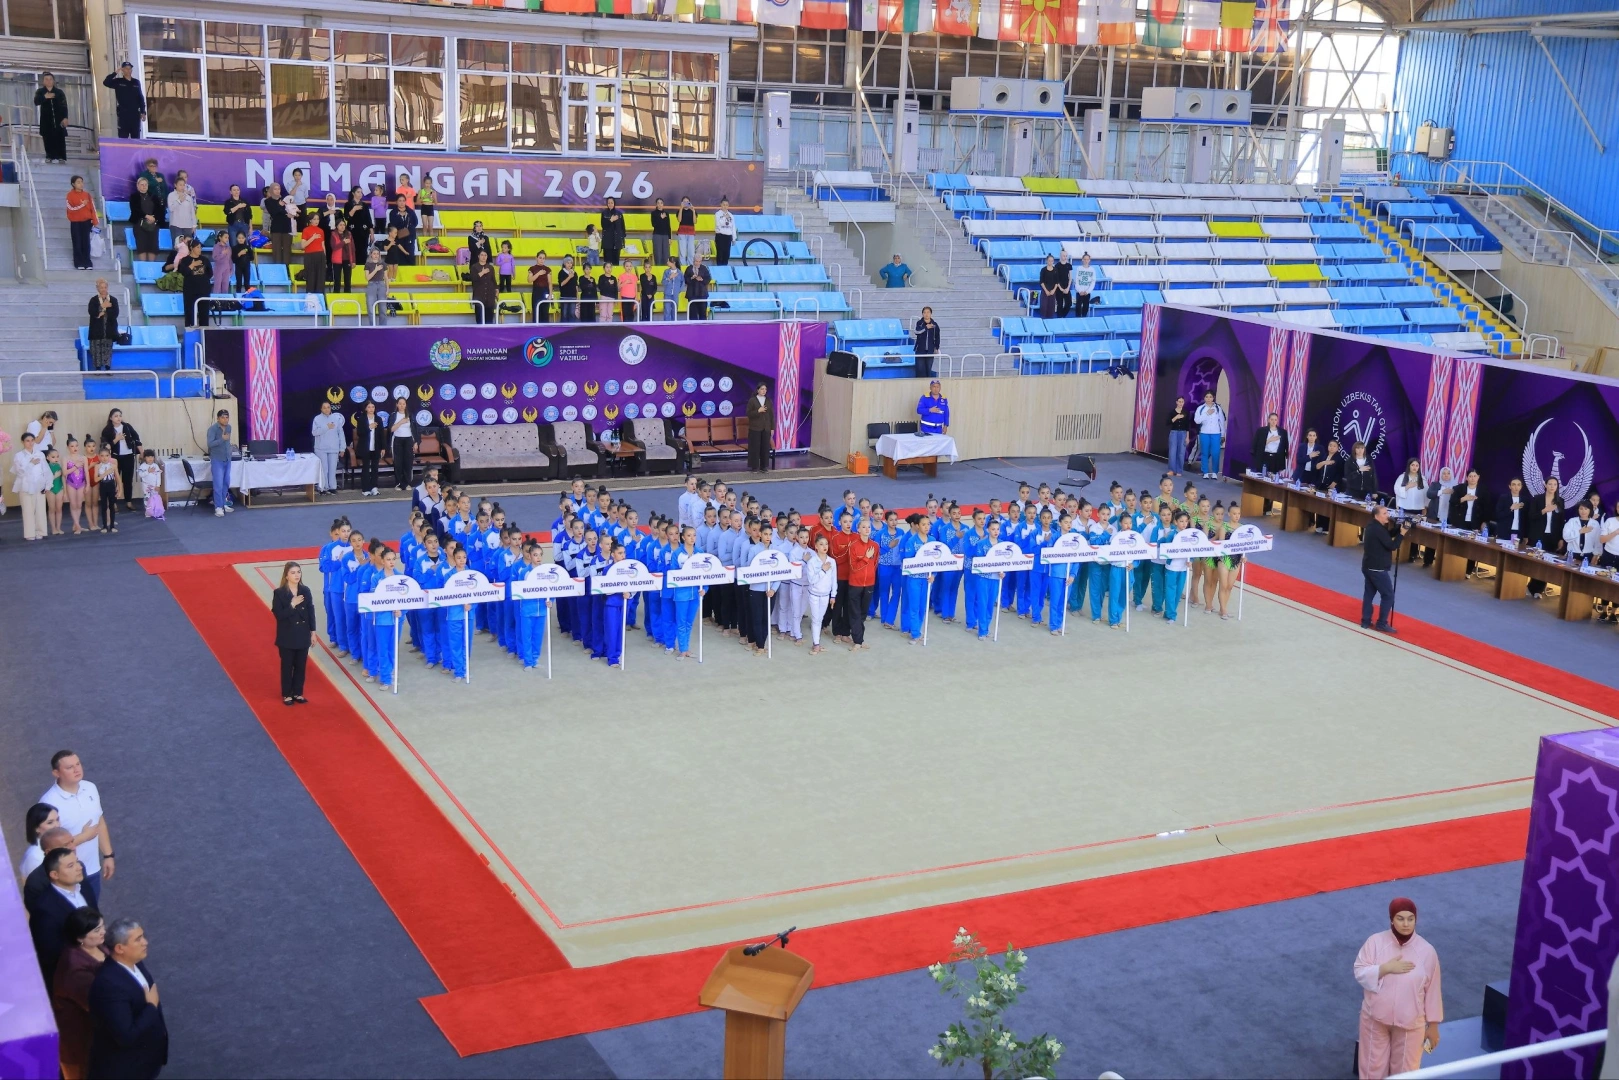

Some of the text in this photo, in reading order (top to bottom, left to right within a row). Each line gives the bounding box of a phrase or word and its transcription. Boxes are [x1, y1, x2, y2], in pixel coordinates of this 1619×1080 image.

[245, 158, 654, 199] NAMANGAN 2026
[1340, 392, 1382, 416] UZBEKISTAN
[1370, 418, 1386, 460] GYMNAS
[434, 593, 472, 601] NAMANGAN
